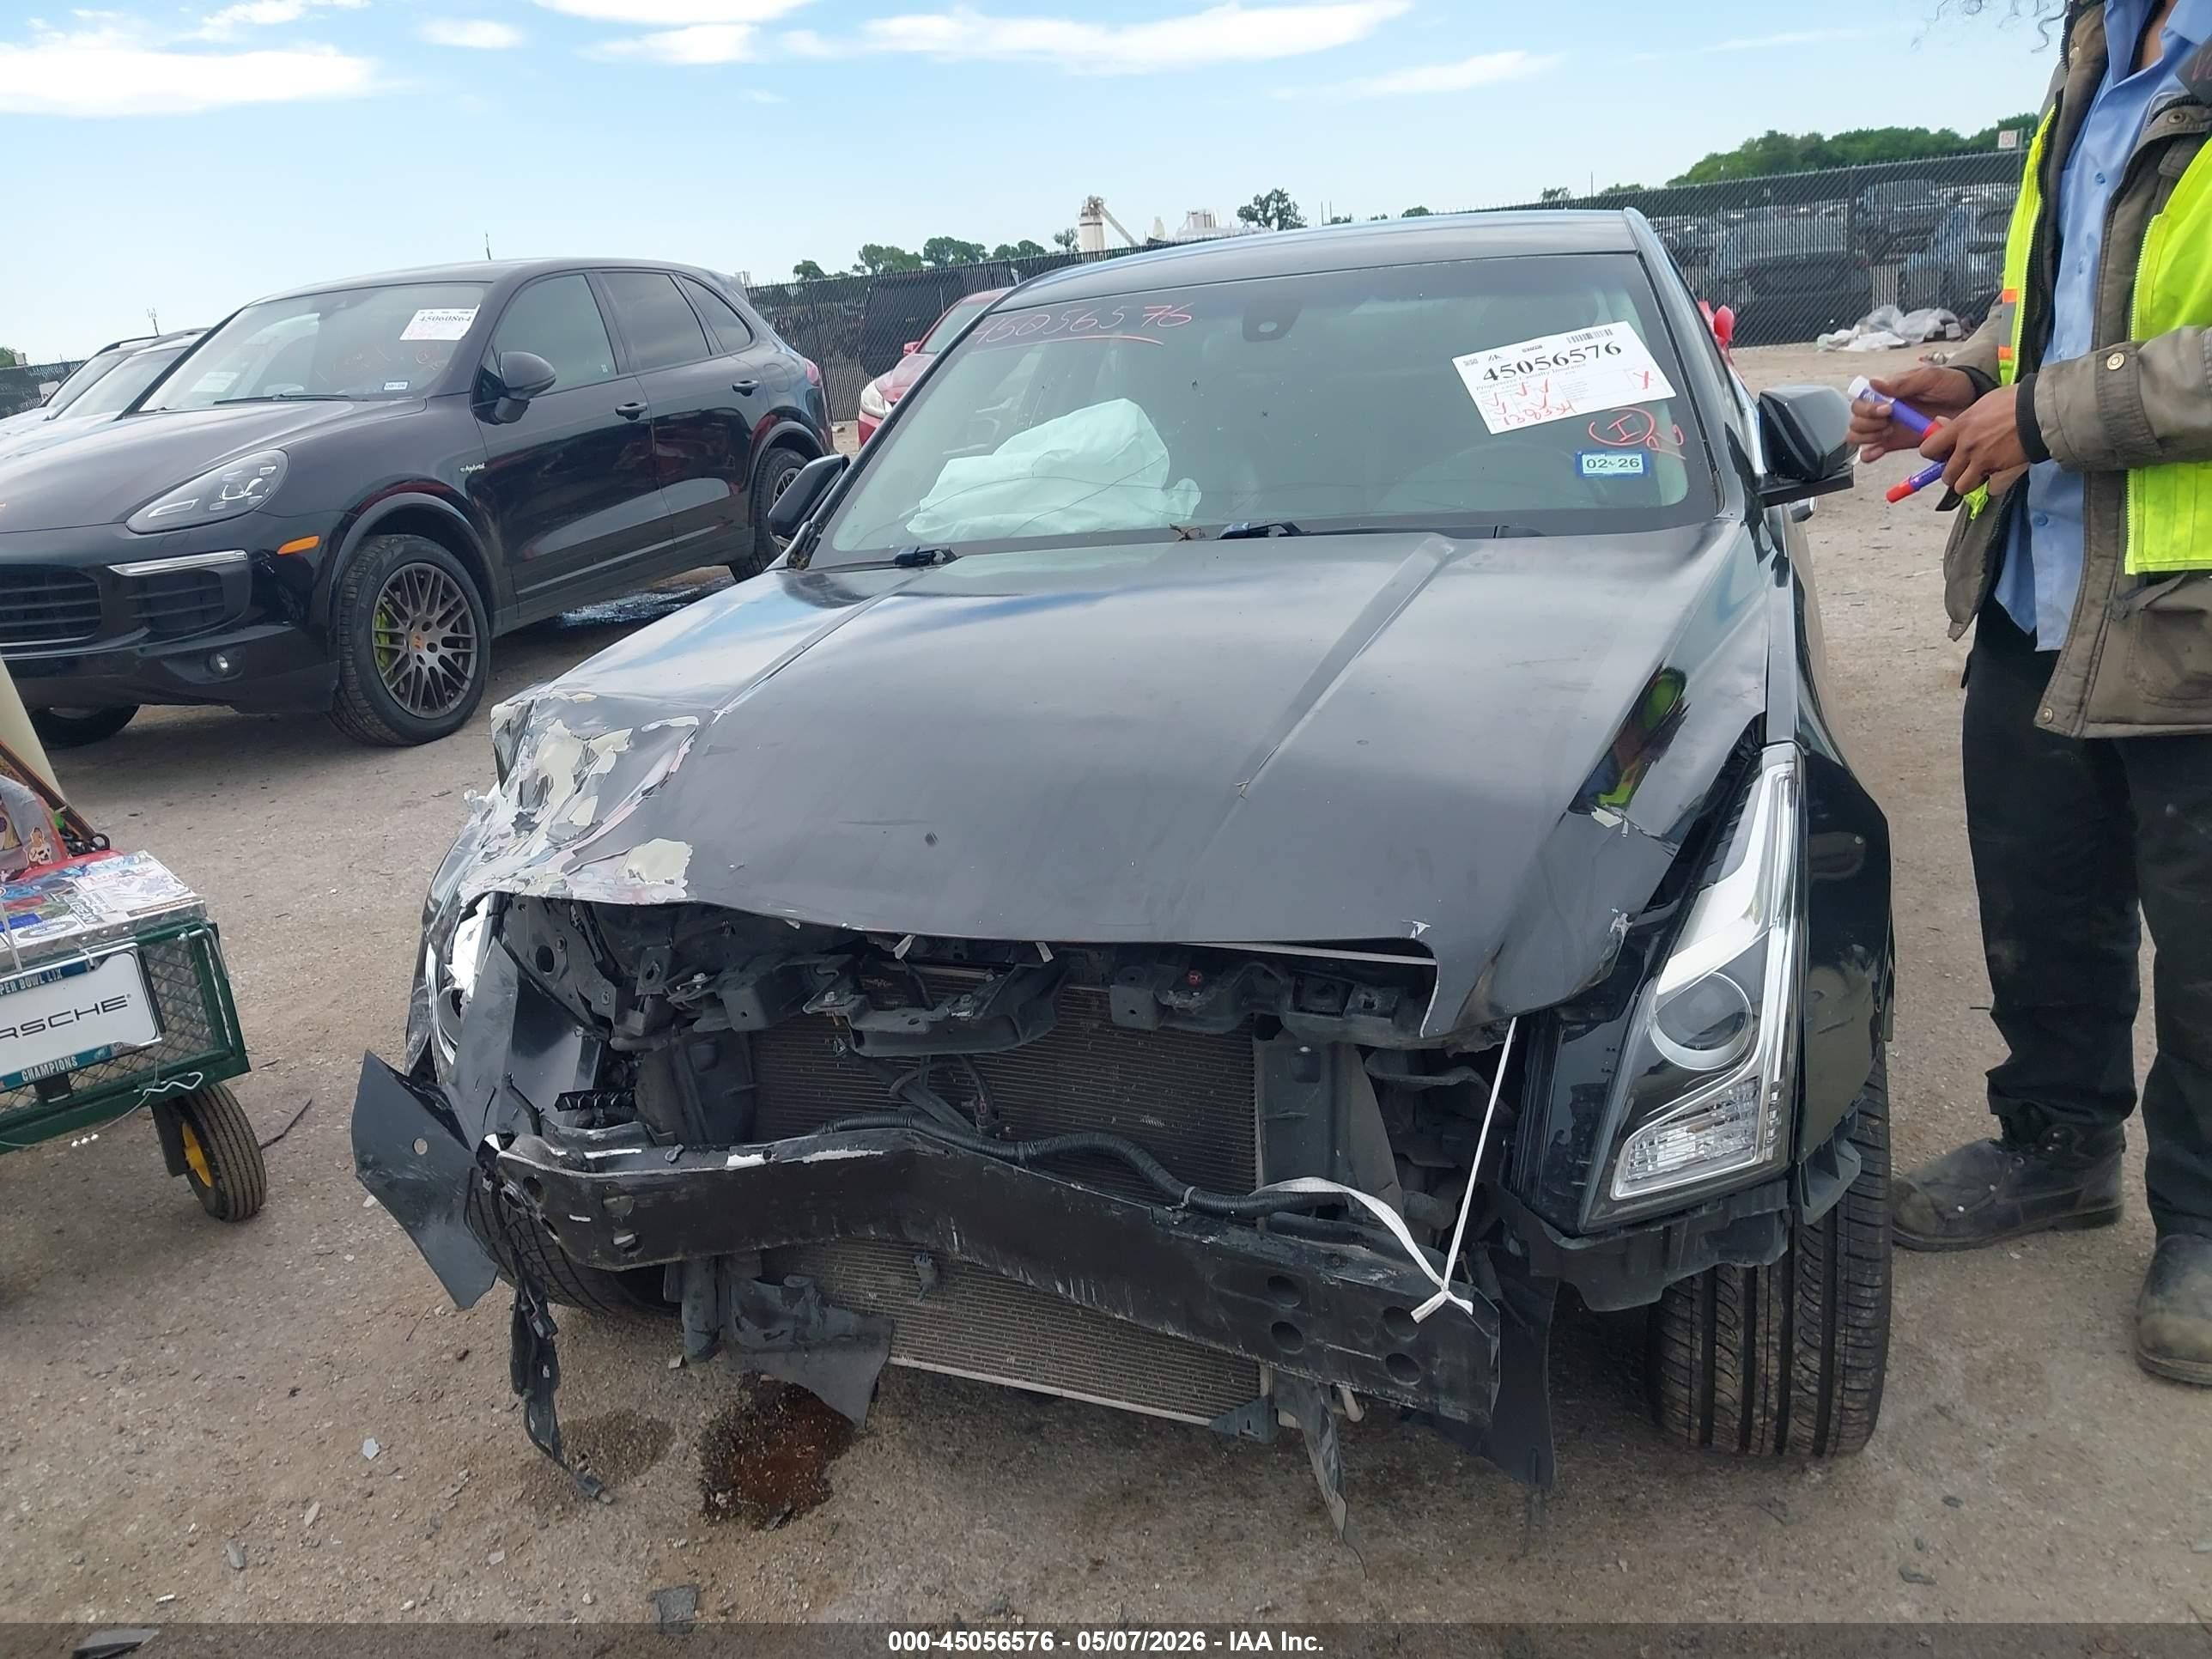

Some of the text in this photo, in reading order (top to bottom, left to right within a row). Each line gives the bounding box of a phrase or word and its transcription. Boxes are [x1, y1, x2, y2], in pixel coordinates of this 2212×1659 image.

[1483, 341, 1621, 381] 45056576
[19, 973, 46, 990] BOWL
[46, 968, 64, 983] LIX
[21, 1055, 78, 1082] CHAMPIONS
